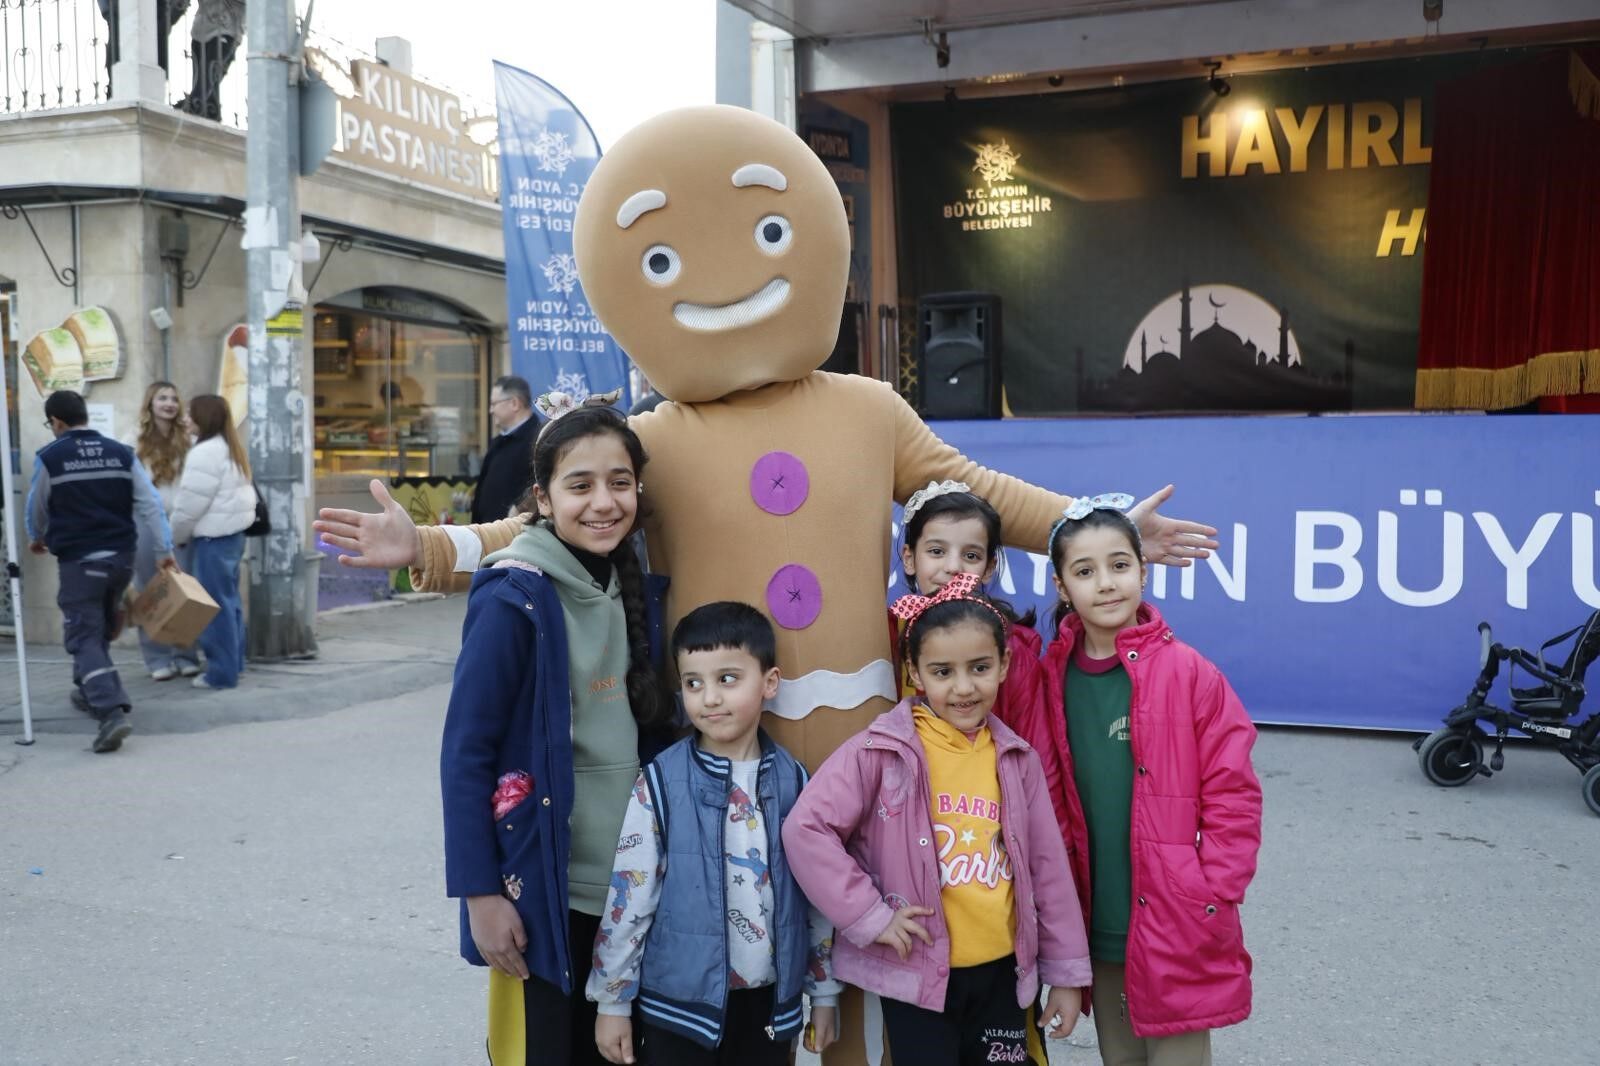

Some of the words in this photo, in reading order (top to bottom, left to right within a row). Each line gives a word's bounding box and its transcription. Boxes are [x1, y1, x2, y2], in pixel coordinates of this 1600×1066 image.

[361, 67, 460, 145] KILINÇ
[342, 111, 482, 189] PASTANESİ
[966, 188, 988, 199] T.C.
[990, 185, 1028, 198] AYDIN
[943, 195, 1052, 218] BÜYÜKŞEHİR
[962, 215, 1033, 231] BELEDİYESİ
[1375, 207, 1428, 257] H
[77, 446, 104, 457] 187
